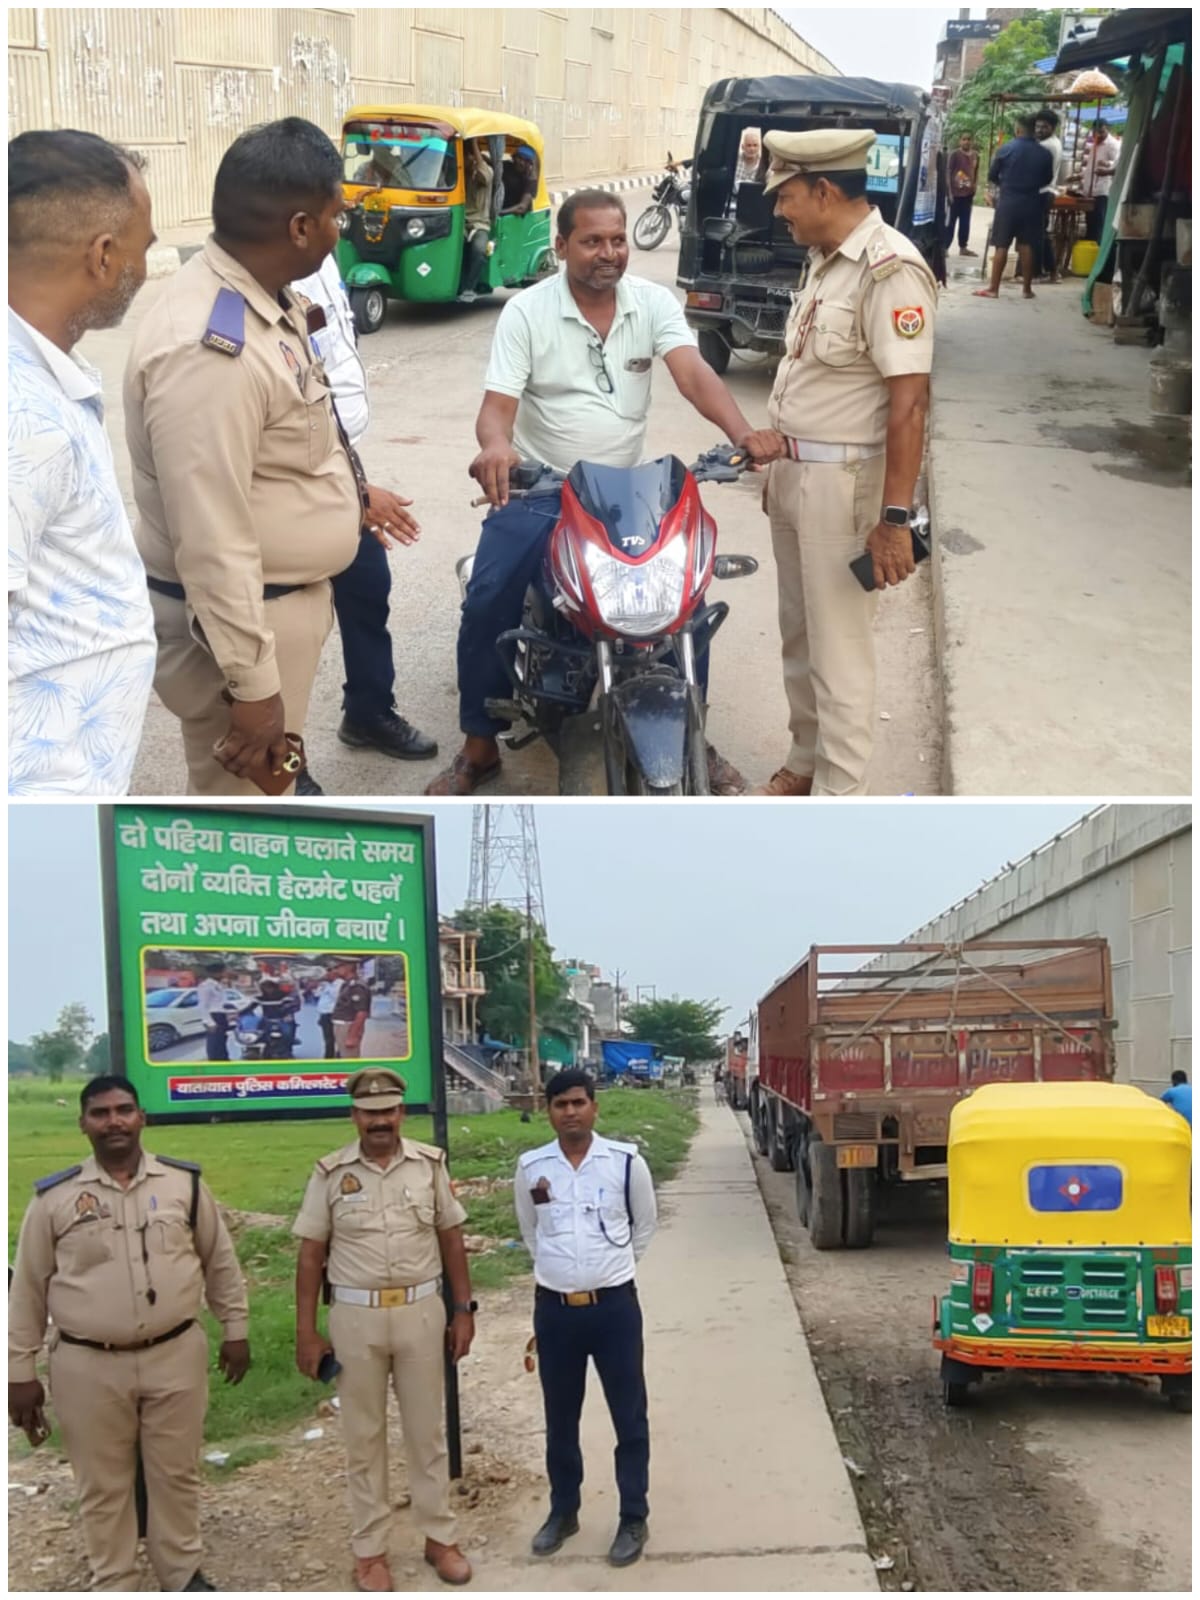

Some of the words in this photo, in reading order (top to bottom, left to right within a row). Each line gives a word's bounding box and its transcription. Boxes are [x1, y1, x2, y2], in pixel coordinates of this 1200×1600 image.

[621, 536, 646, 547] TVS
[120, 818, 148, 849] दो
[154, 819, 223, 854] पहिया
[230, 831, 289, 859] वाहन
[295, 832, 357, 862] चलाते
[362, 841, 415, 864] समय
[141, 861, 198, 894] दोनों
[202, 864, 272, 897] व्यक्ति
[277, 868, 348, 901] हेलमेट
[351, 874, 403, 904] पहनें
[140, 911, 188, 935] तथा
[193, 914, 260, 937] अपना
[265, 907, 331, 939] जीवन
[335, 913, 392, 941] बचाएं
[236, 1077, 274, 1097] पुलिस
[1026, 1287, 1059, 1298] KEEP
